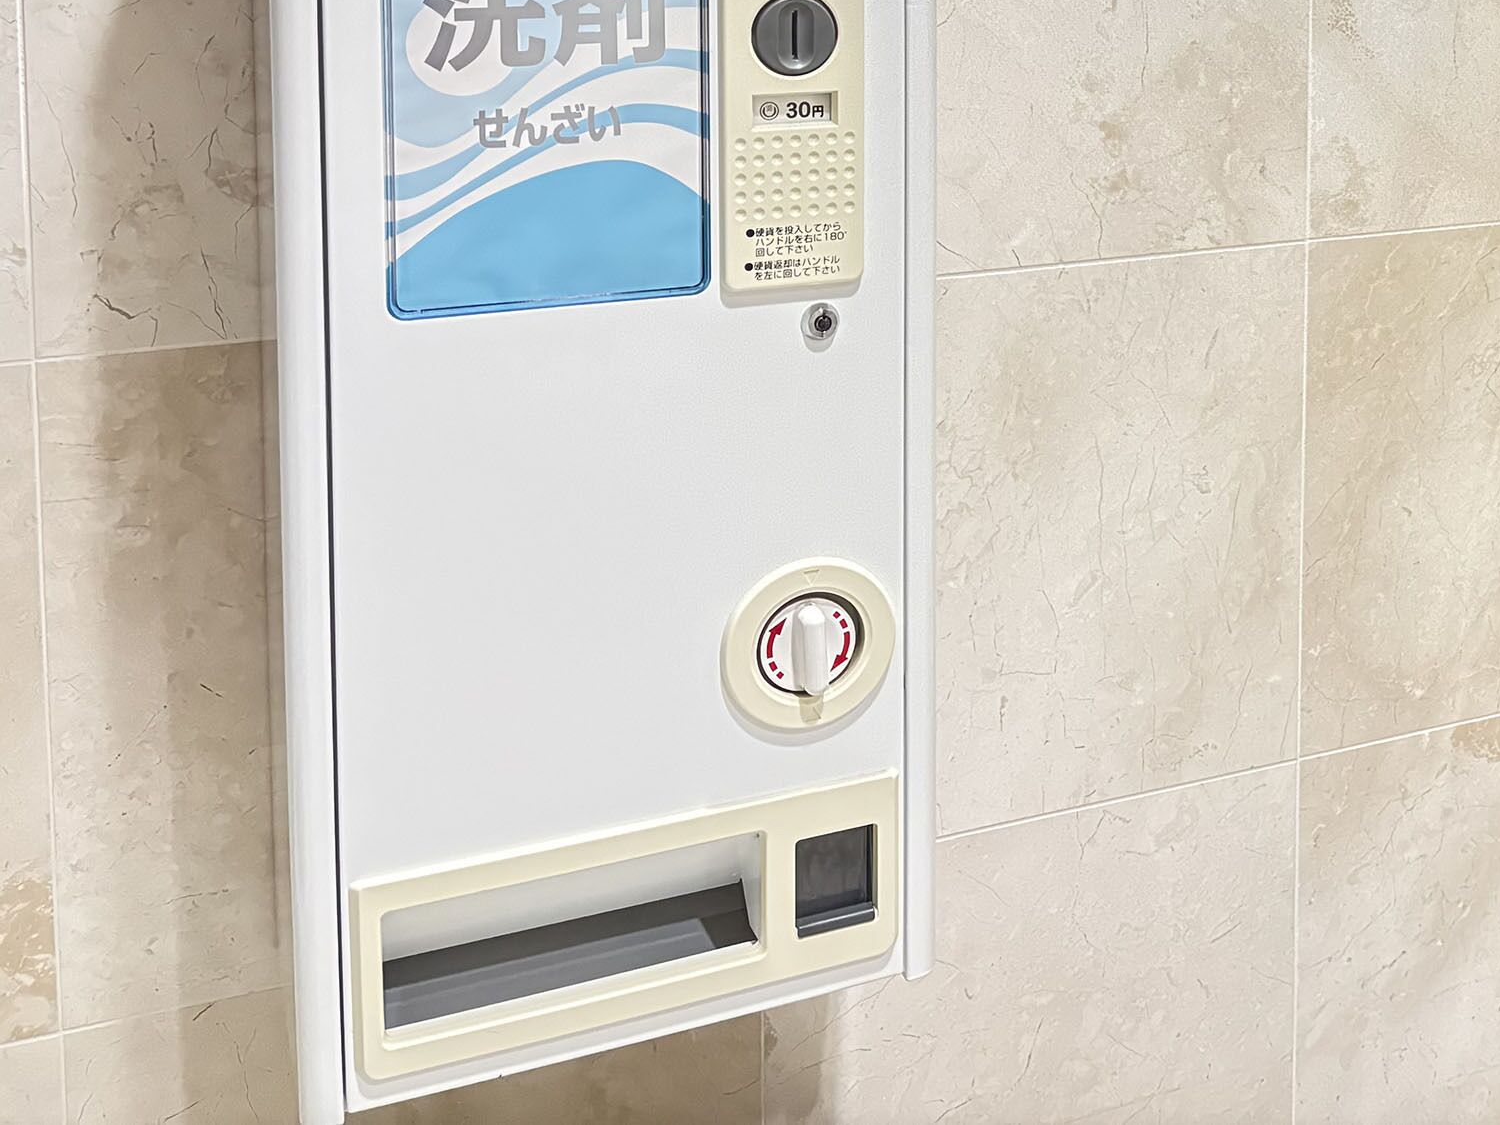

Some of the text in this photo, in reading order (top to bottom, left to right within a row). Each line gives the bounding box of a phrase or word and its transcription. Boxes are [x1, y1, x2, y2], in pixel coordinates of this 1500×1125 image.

[786, 101, 824, 119] 30円
[472, 103, 622, 149] せんざい
[755, 222, 841, 237] 硬貨を投入してから
[755, 243, 814, 258] 回して下さい
[753, 255, 840, 271] 硬貨返却はハンドル
[754, 265, 840, 280] を左に回して下さい
